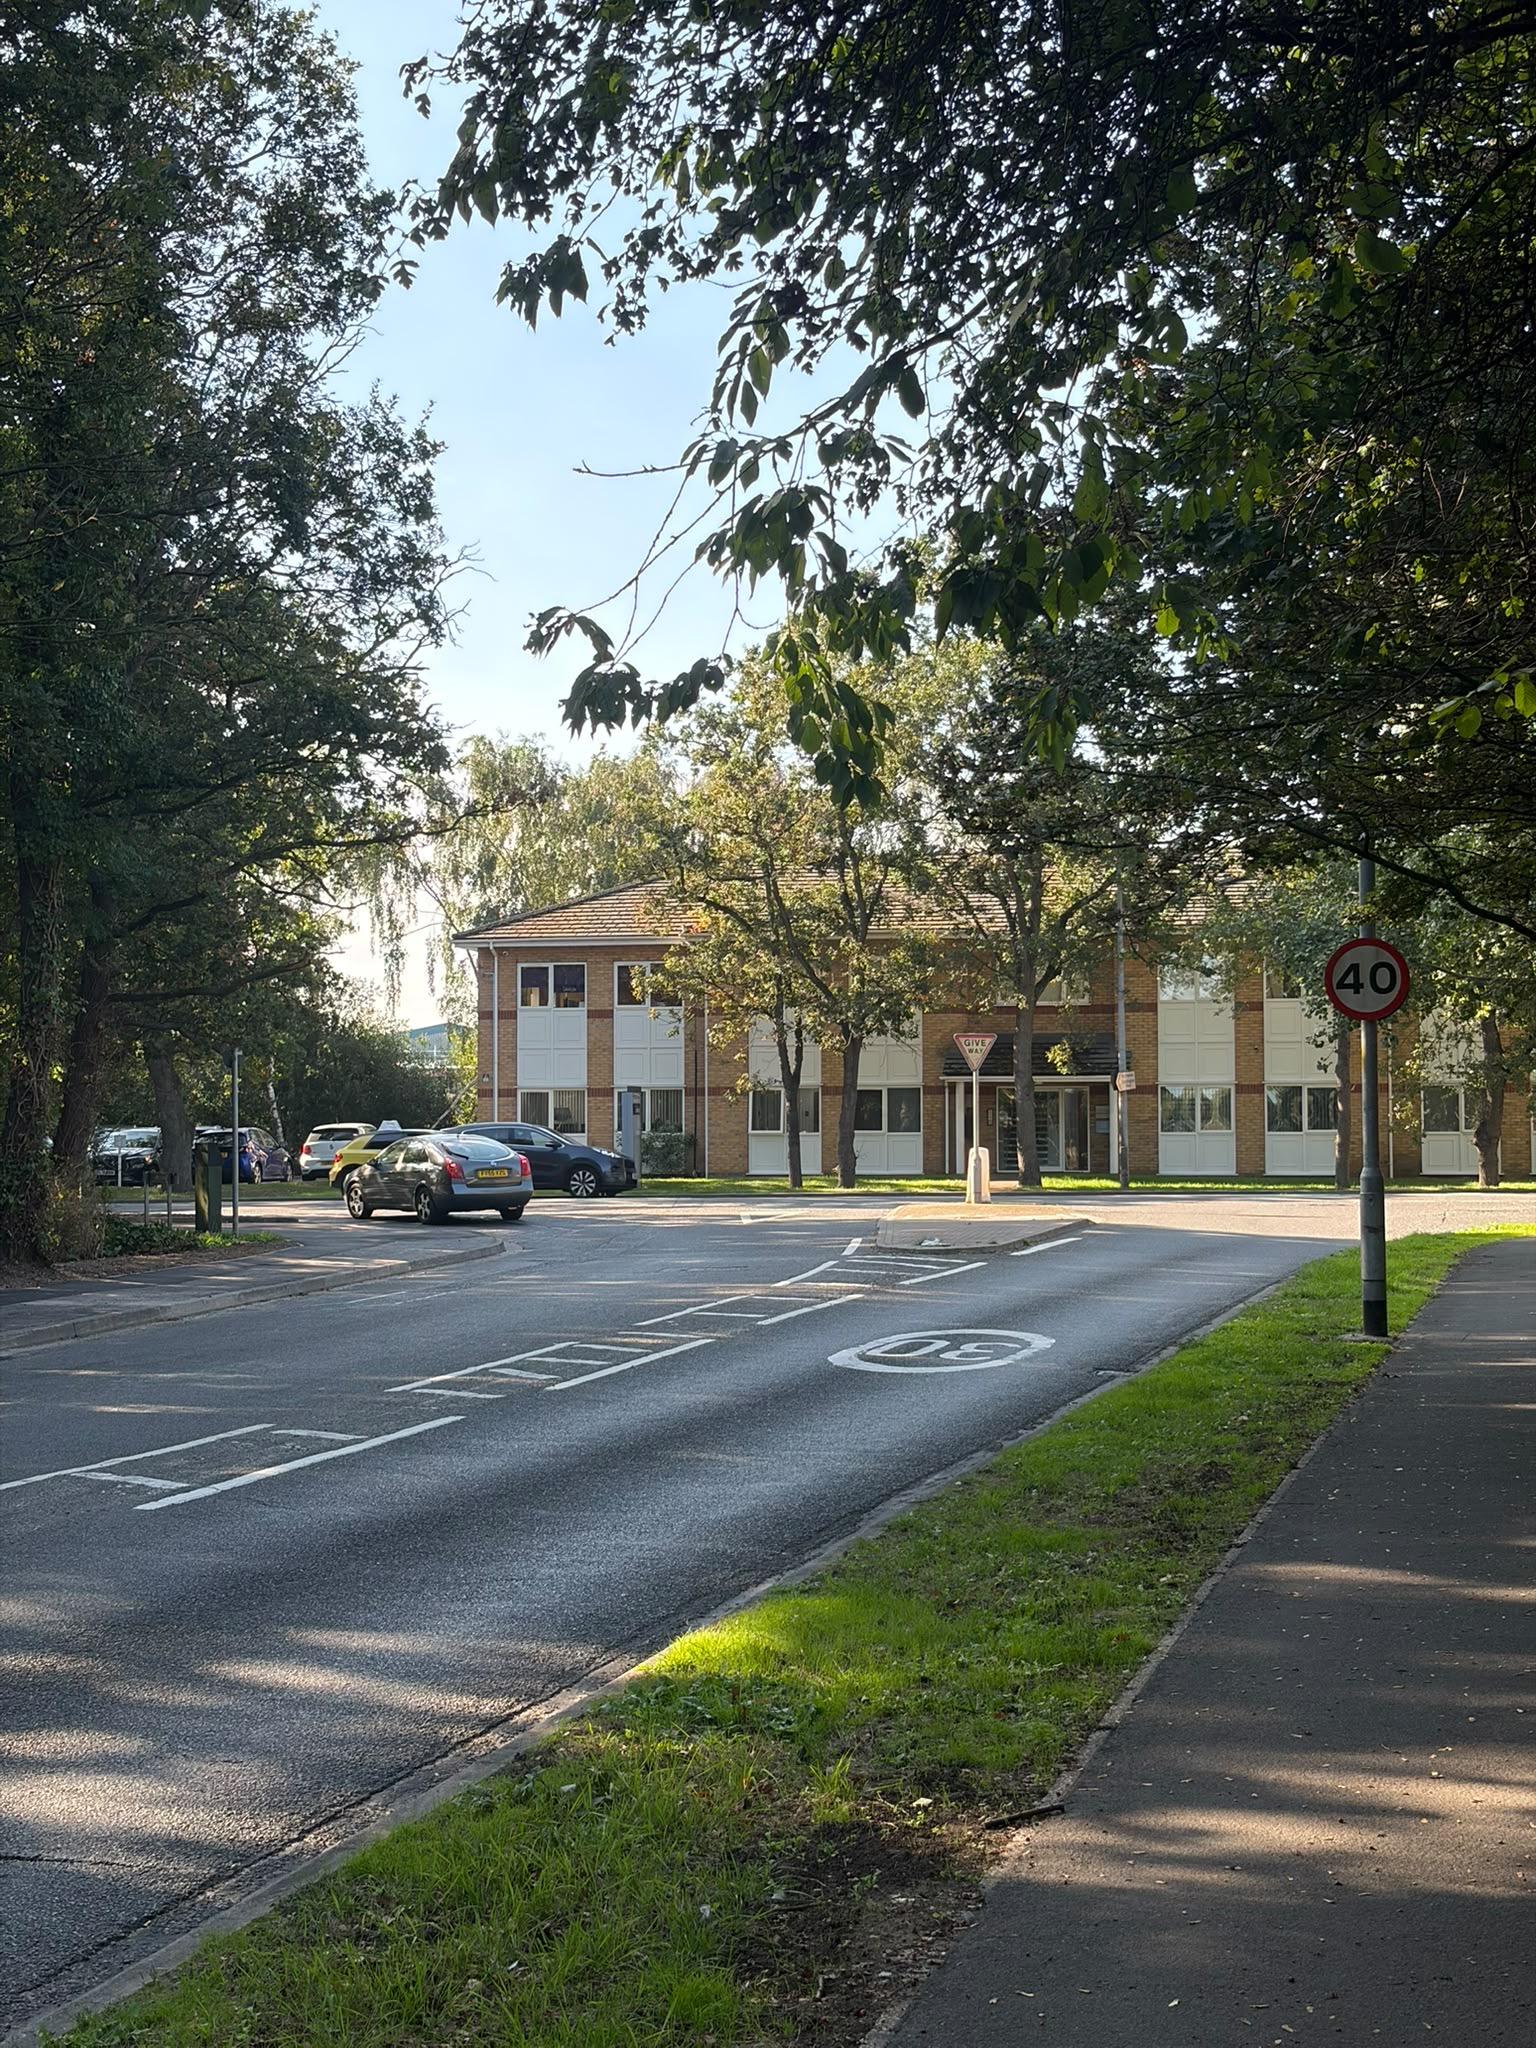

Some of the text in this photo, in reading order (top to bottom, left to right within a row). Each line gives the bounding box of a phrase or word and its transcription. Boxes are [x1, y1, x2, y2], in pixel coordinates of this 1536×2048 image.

[1335, 961, 1397, 995] 40
[963, 1039, 986, 1047] GIVE
[864, 1338, 1022, 1361] 30
